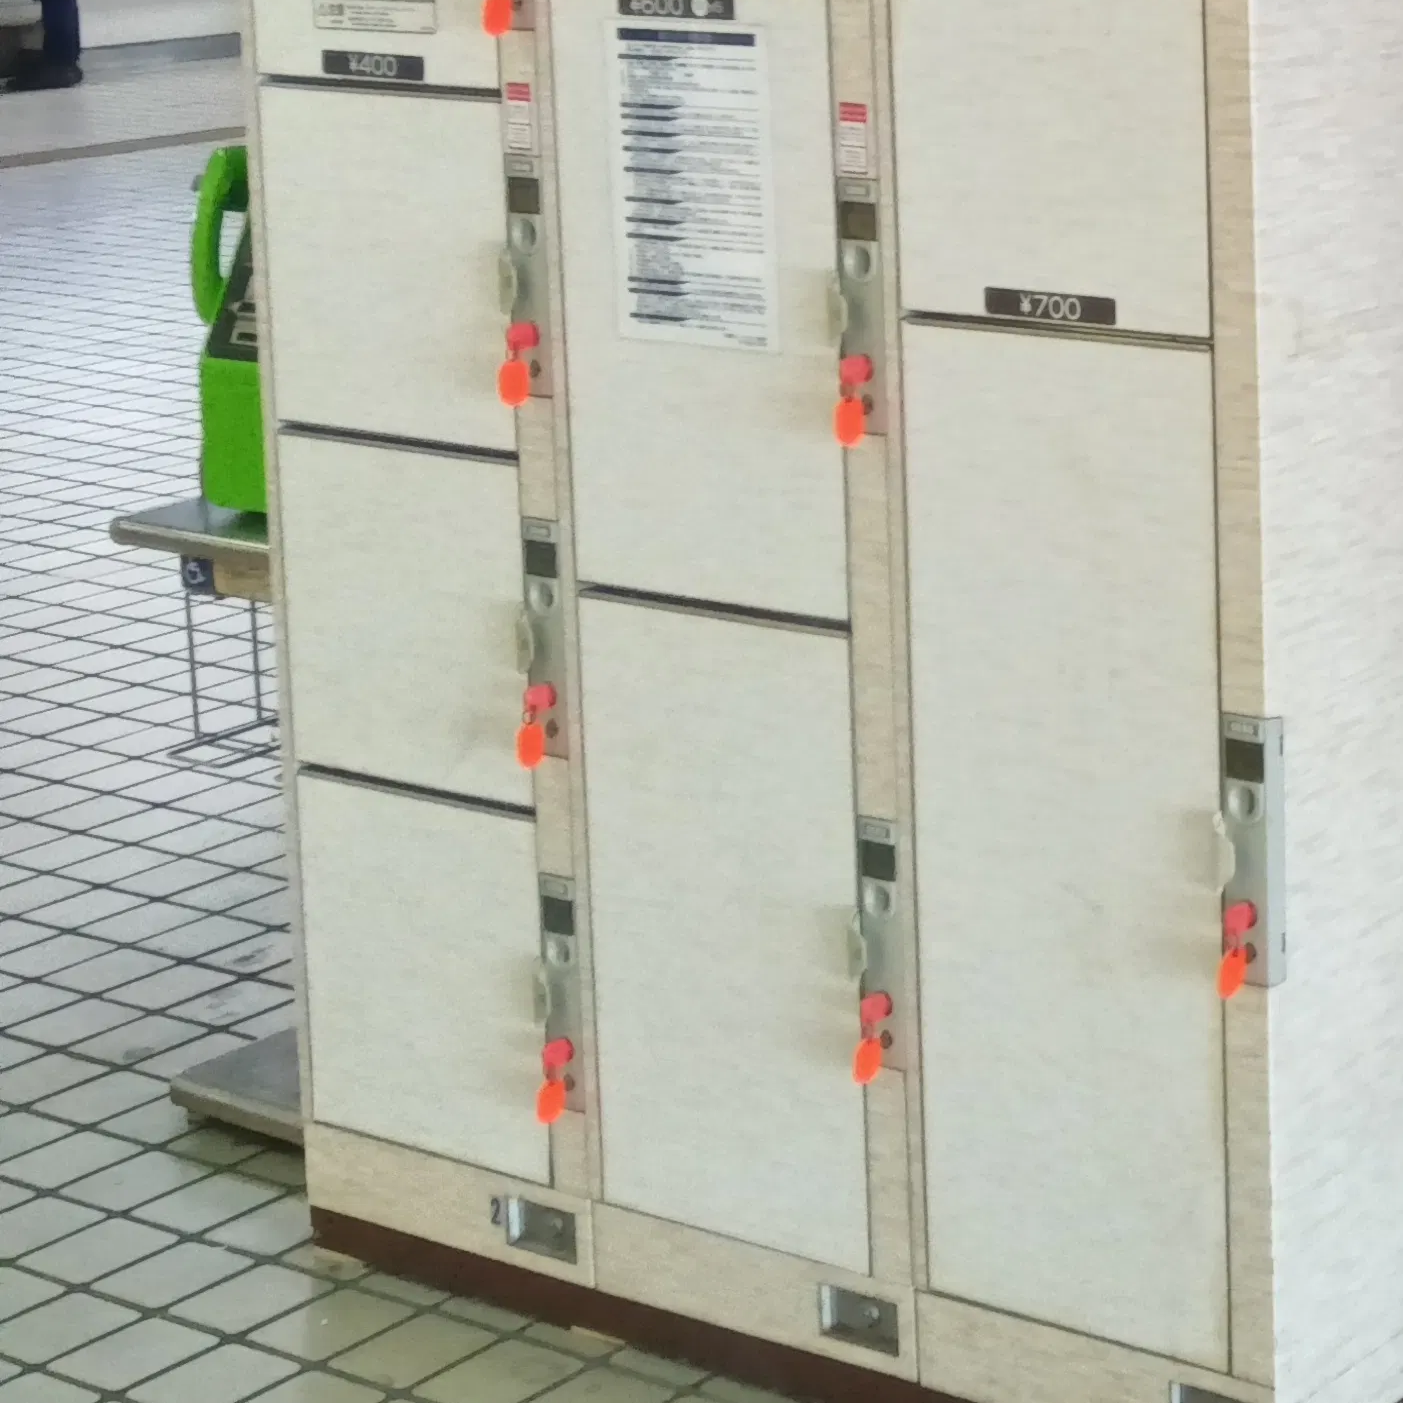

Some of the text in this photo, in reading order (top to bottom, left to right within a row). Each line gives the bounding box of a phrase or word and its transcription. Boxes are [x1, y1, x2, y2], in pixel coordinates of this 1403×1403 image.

[347, 54, 398, 77] ¥400
[1019, 293, 1082, 321] ¥700
[491, 1198, 501, 1225] 2
